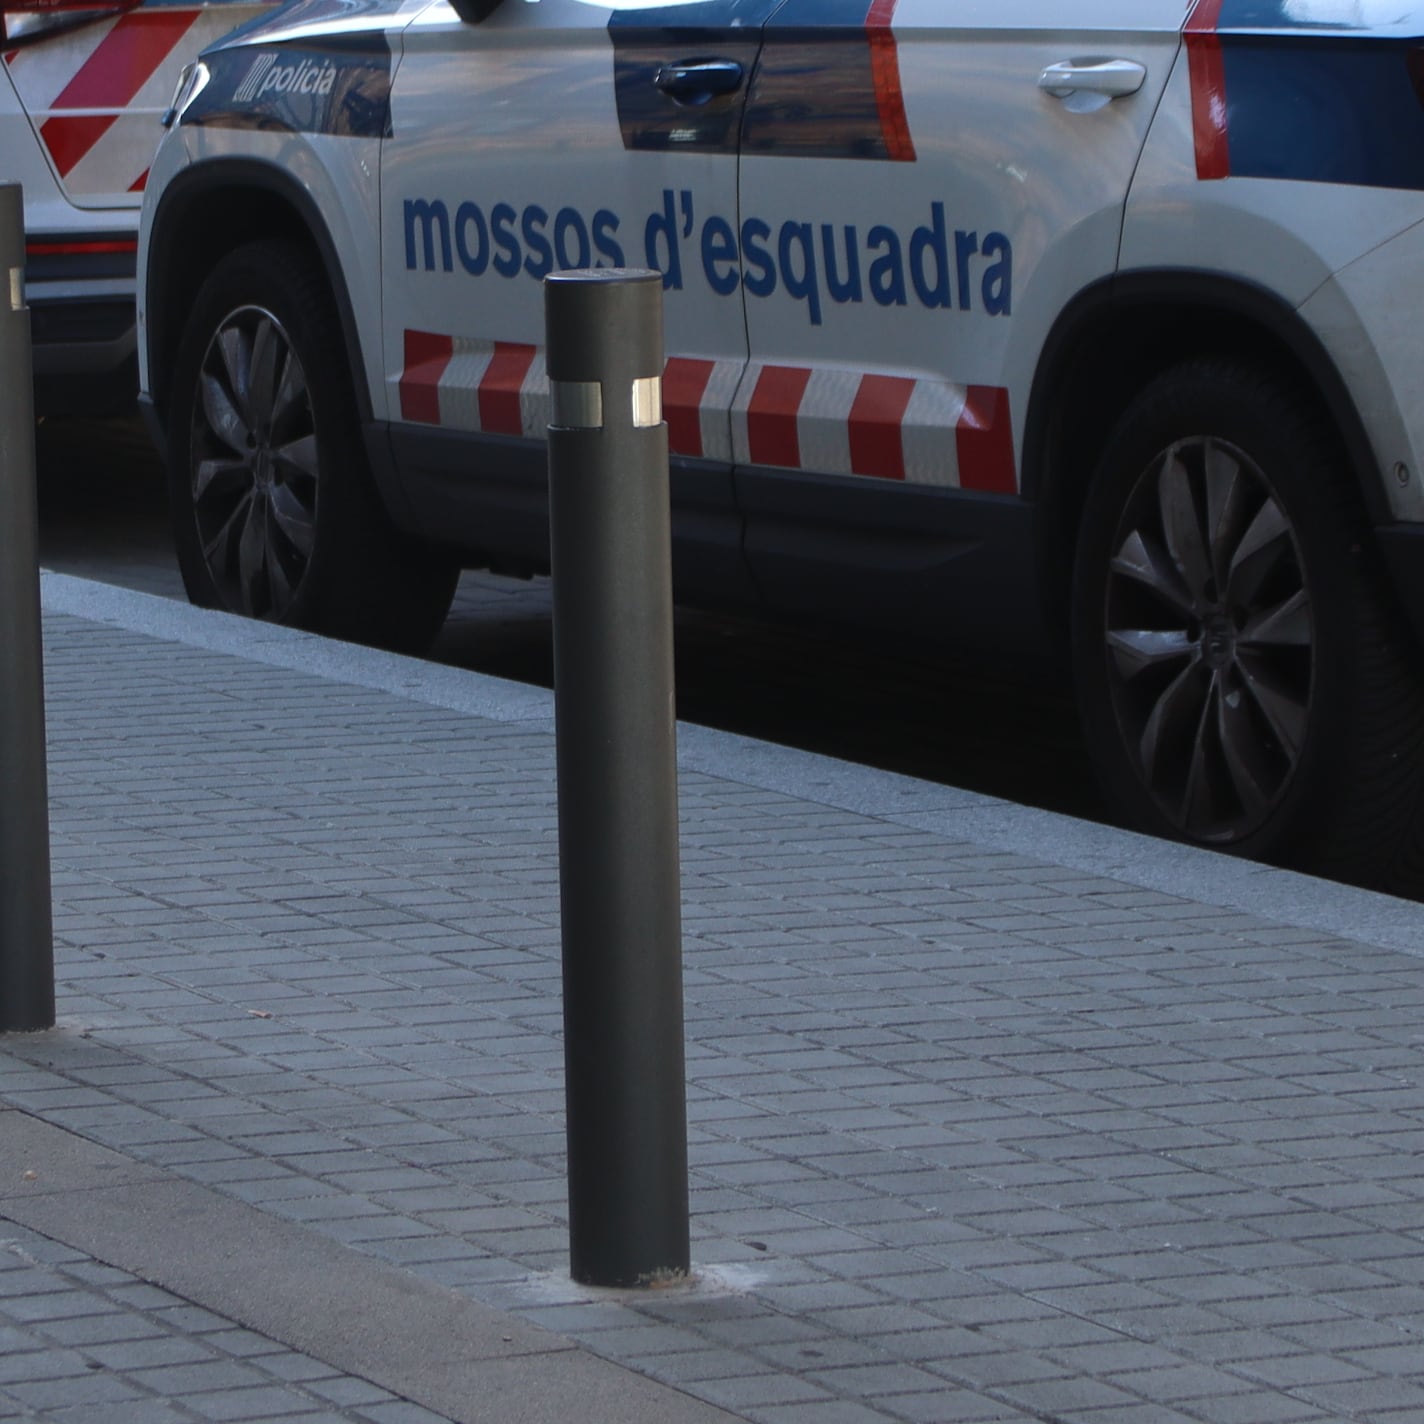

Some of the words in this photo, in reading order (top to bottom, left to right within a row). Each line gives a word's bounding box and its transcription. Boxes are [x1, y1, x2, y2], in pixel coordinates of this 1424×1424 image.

[257, 58, 337, 99] policia
[402, 196, 626, 281] mossos
[644, 188, 1013, 326] d'esquadra
